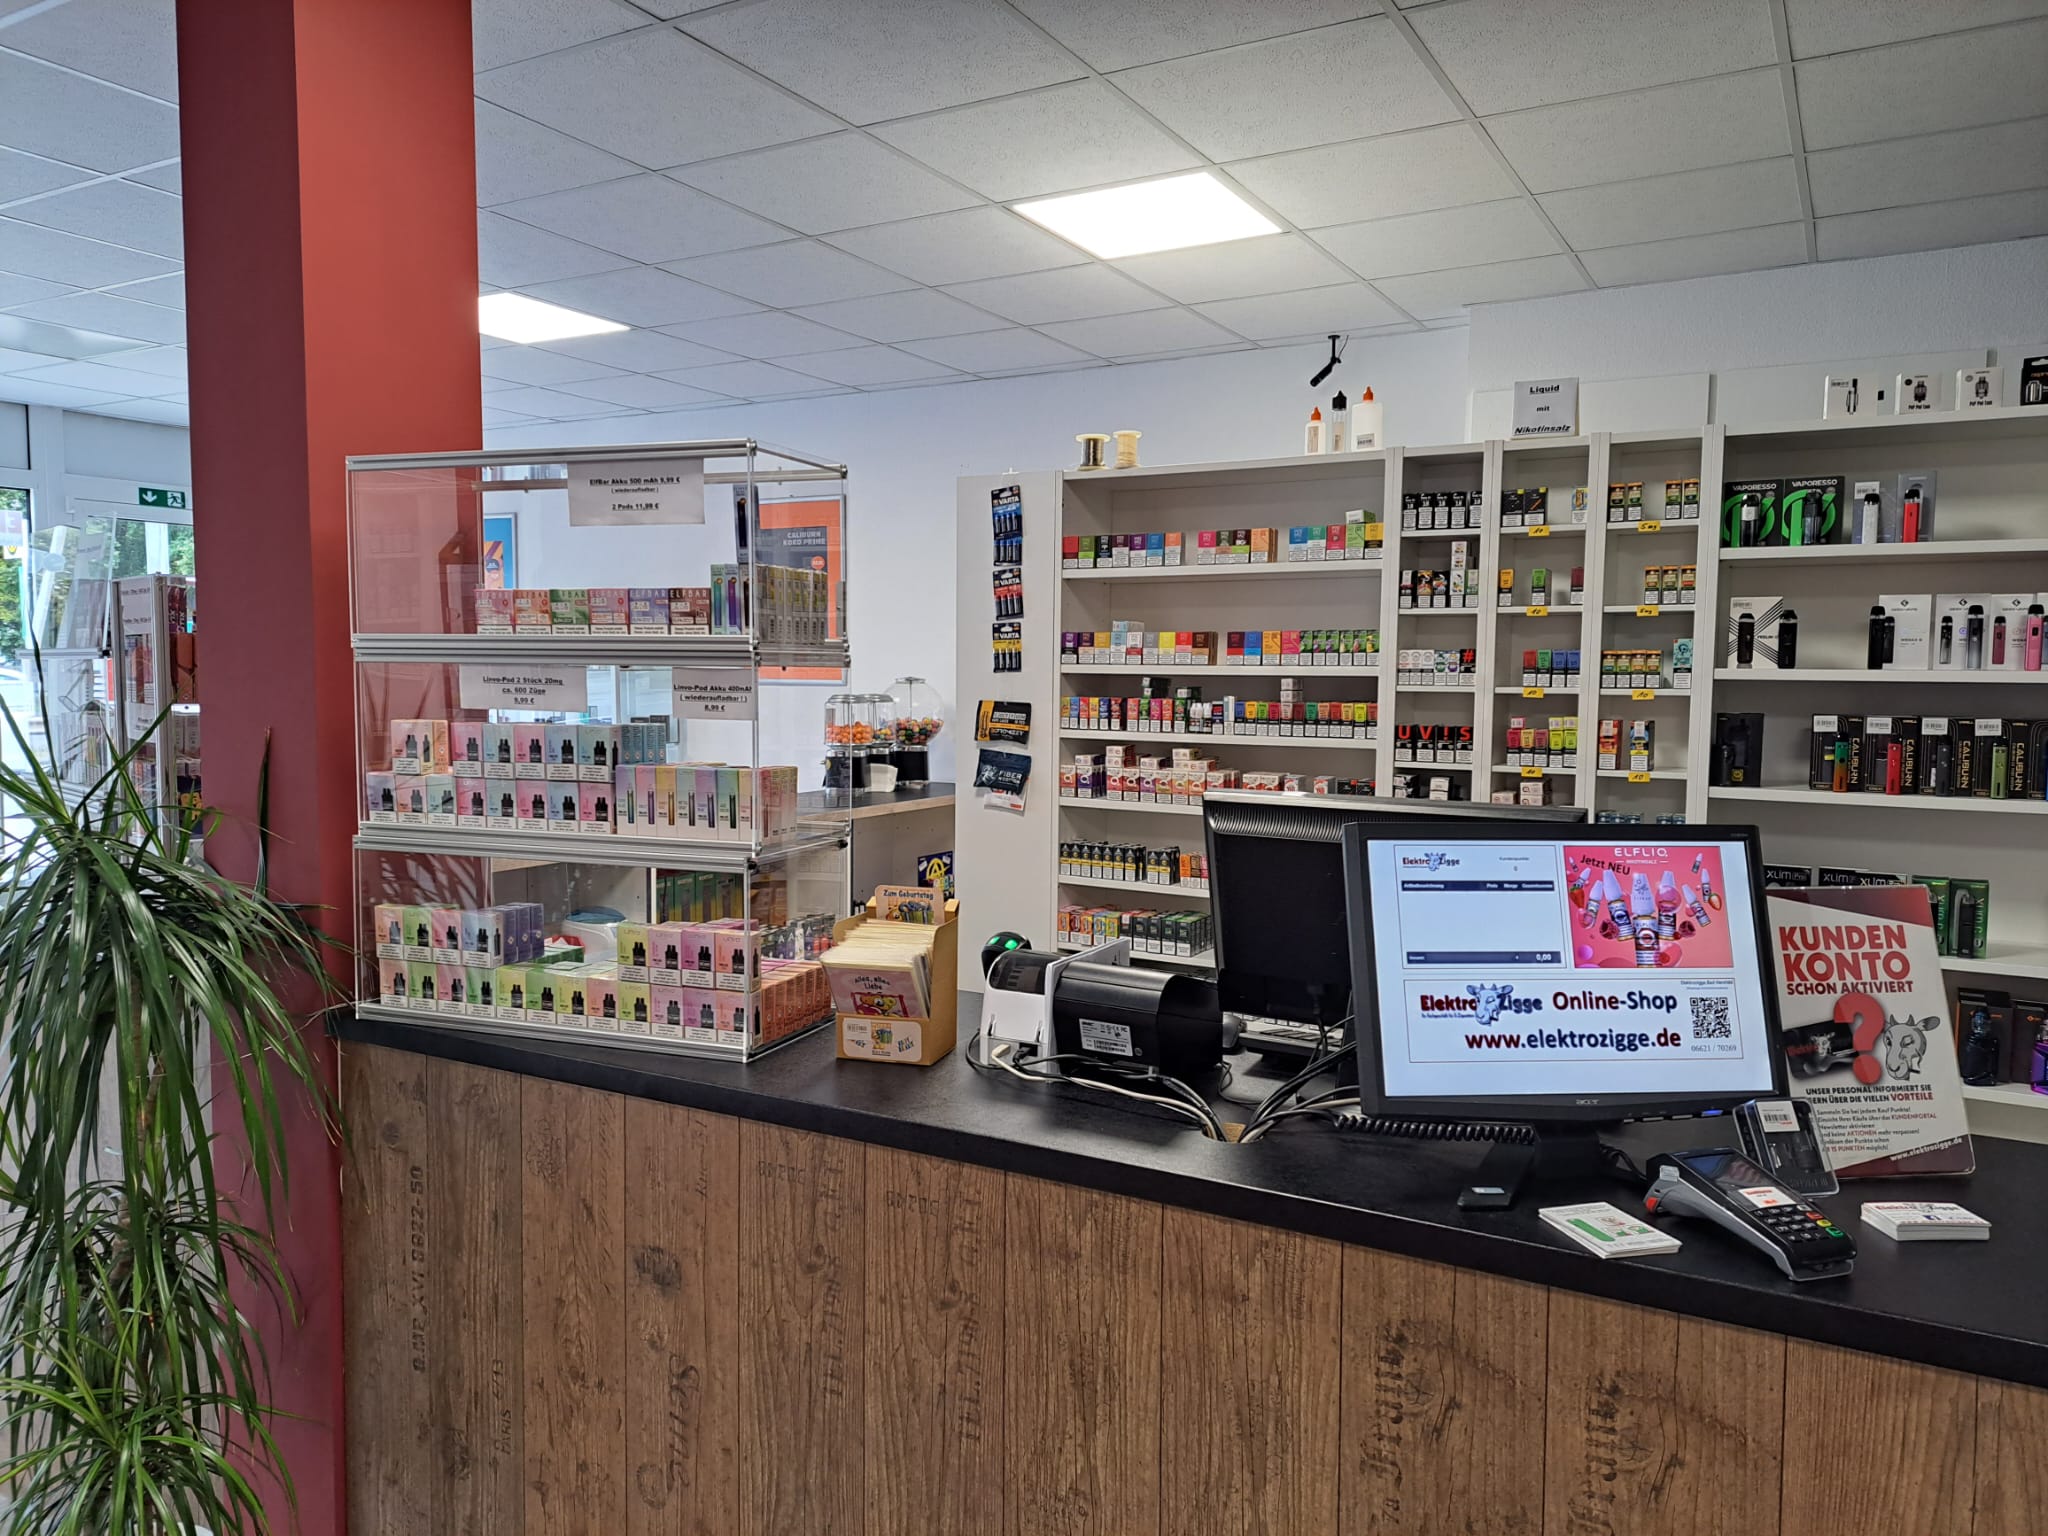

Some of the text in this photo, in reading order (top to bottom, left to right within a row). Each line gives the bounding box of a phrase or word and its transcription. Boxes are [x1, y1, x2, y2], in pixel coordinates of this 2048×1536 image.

[1530, 384, 1560, 395] Liquid
[1514, 424, 1571, 434] Nikotinsalz
[589, 478, 609, 486] ElfBar
[660, 477, 674, 485] 9,99
[1732, 483, 1777, 491] VAPORESSO
[1792, 479, 1838, 487] VAPORESSO
[999, 496, 1020, 505] VARTA
[1000, 577, 1020, 585] VARTA
[670, 590, 708, 598] ELFBAR
[1000, 632, 1020, 640] VARTA
[523, 676, 542, 684] Stück
[544, 678, 563, 686] 20mg
[529, 687, 546, 695] Züge
[1398, 725, 1411, 739] U
[1420, 725, 1433, 740] V
[1460, 726, 1471, 740] S
[1852, 738, 1860, 785] CALIBURN
[1905, 739, 1915, 787] CALIBURN
[1961, 740, 1971, 789] CALIBURN
[2015, 742, 2025, 791] CALIBURN
[999, 770, 1022, 779] FIBER
[1614, 847, 1668, 857] ELFLIQ
[1580, 854, 1631, 876] Jetzt NEU
[883, 889, 934, 900] Zum Geburtstag
[1779, 925, 1907, 951] KUNDEN
[1536, 953, 1552, 962] 0,00
[1783, 951, 1910, 981] KONTO
[864, 983, 882, 991] Liebe
[1787, 980, 1913, 995] SCHON AKTIVIERT
[1553, 990, 1677, 1014] Online-Shop
[1465, 1027, 1681, 1052] www.elektrozigge.de
[1691, 1044, 1710, 1052] 06621
[1806, 1084, 1931, 1095] UNSER PERSONAL INFORMIERT SIE
[1808, 1097, 1828, 1105] ERN
[1829, 1094, 1849, 1104] ÜBER
[1863, 1095, 1889, 1103] VIELEN
[1890, 1092, 1933, 1102] VORTEILE
[1890, 1136, 1963, 1161] www.elektrozigge.de
